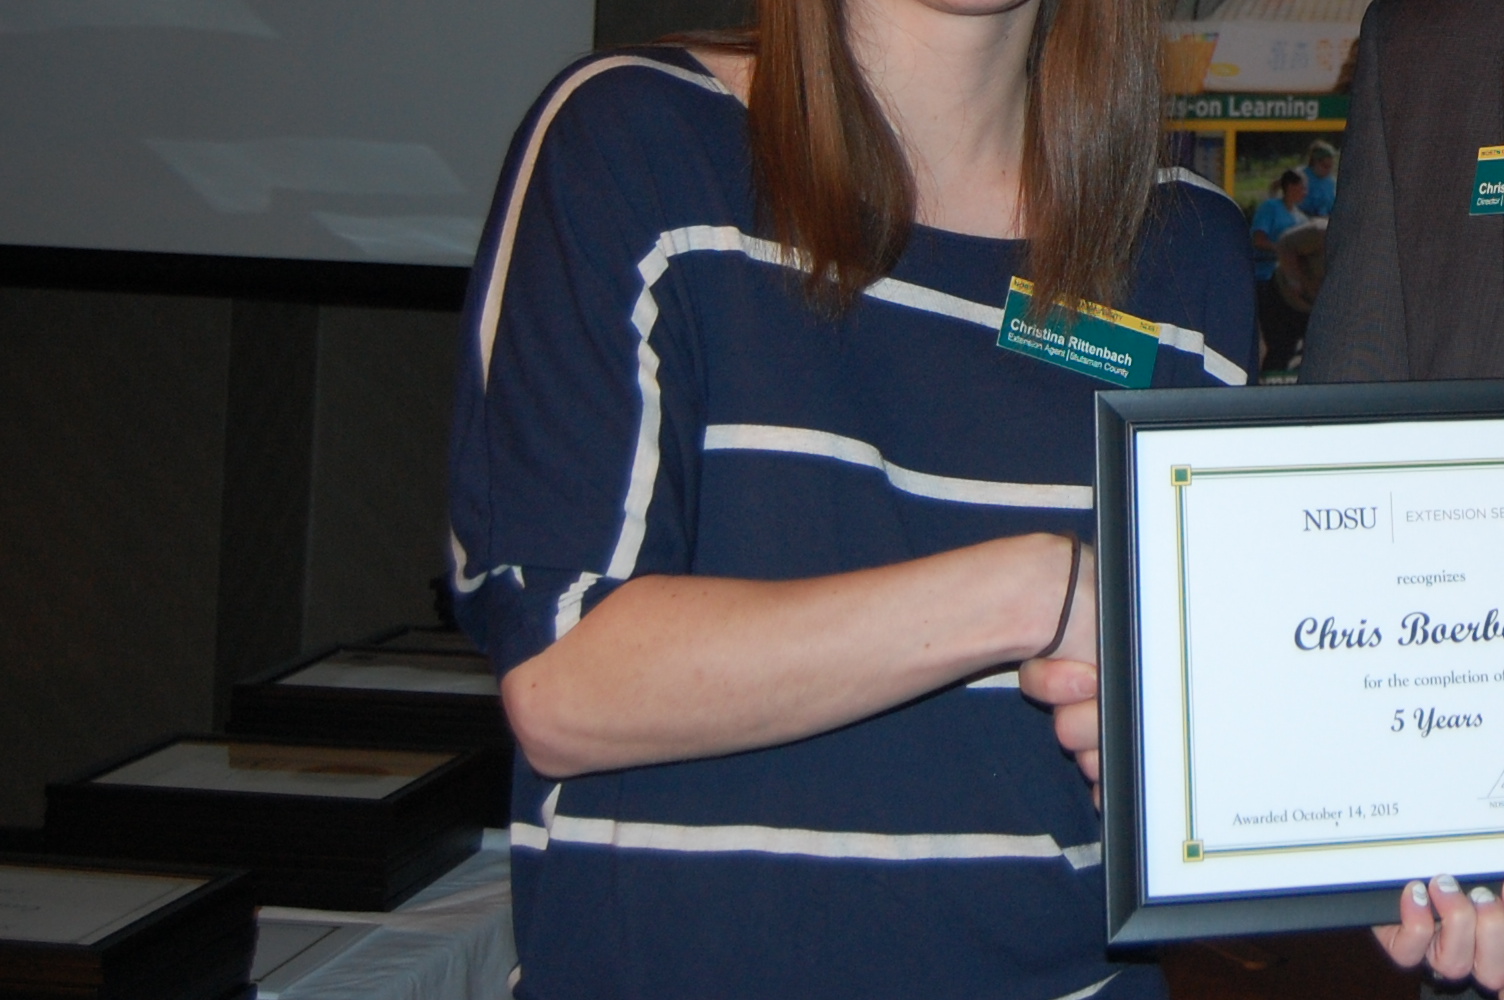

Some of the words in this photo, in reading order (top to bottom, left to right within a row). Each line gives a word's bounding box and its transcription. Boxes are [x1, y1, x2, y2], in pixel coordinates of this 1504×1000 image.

[1229, 95, 1319, 121] Learning
[1476, 197, 1500, 206] Director
[1008, 332, 1043, 350] Extension
[1010, 317, 1066, 346] Christina
[1068, 335, 1133, 367] Rittenbach
[1303, 507, 1377, 532] NDSU
[1406, 508, 1487, 523] EXTENSION
[1397, 569, 1466, 587] recognizes
[1294, 616, 1382, 651] Chris
[1363, 673, 1383, 690] for
[1387, 672, 1410, 688] the
[1414, 669, 1489, 689] completion
[1391, 708, 1405, 733] 5
[1413, 706, 1483, 738] Years
[1232, 809, 1288, 826] Awarded
[1292, 806, 1343, 822] October
[1349, 805, 1366, 819] 14,
[1370, 802, 1399, 817] 2015
